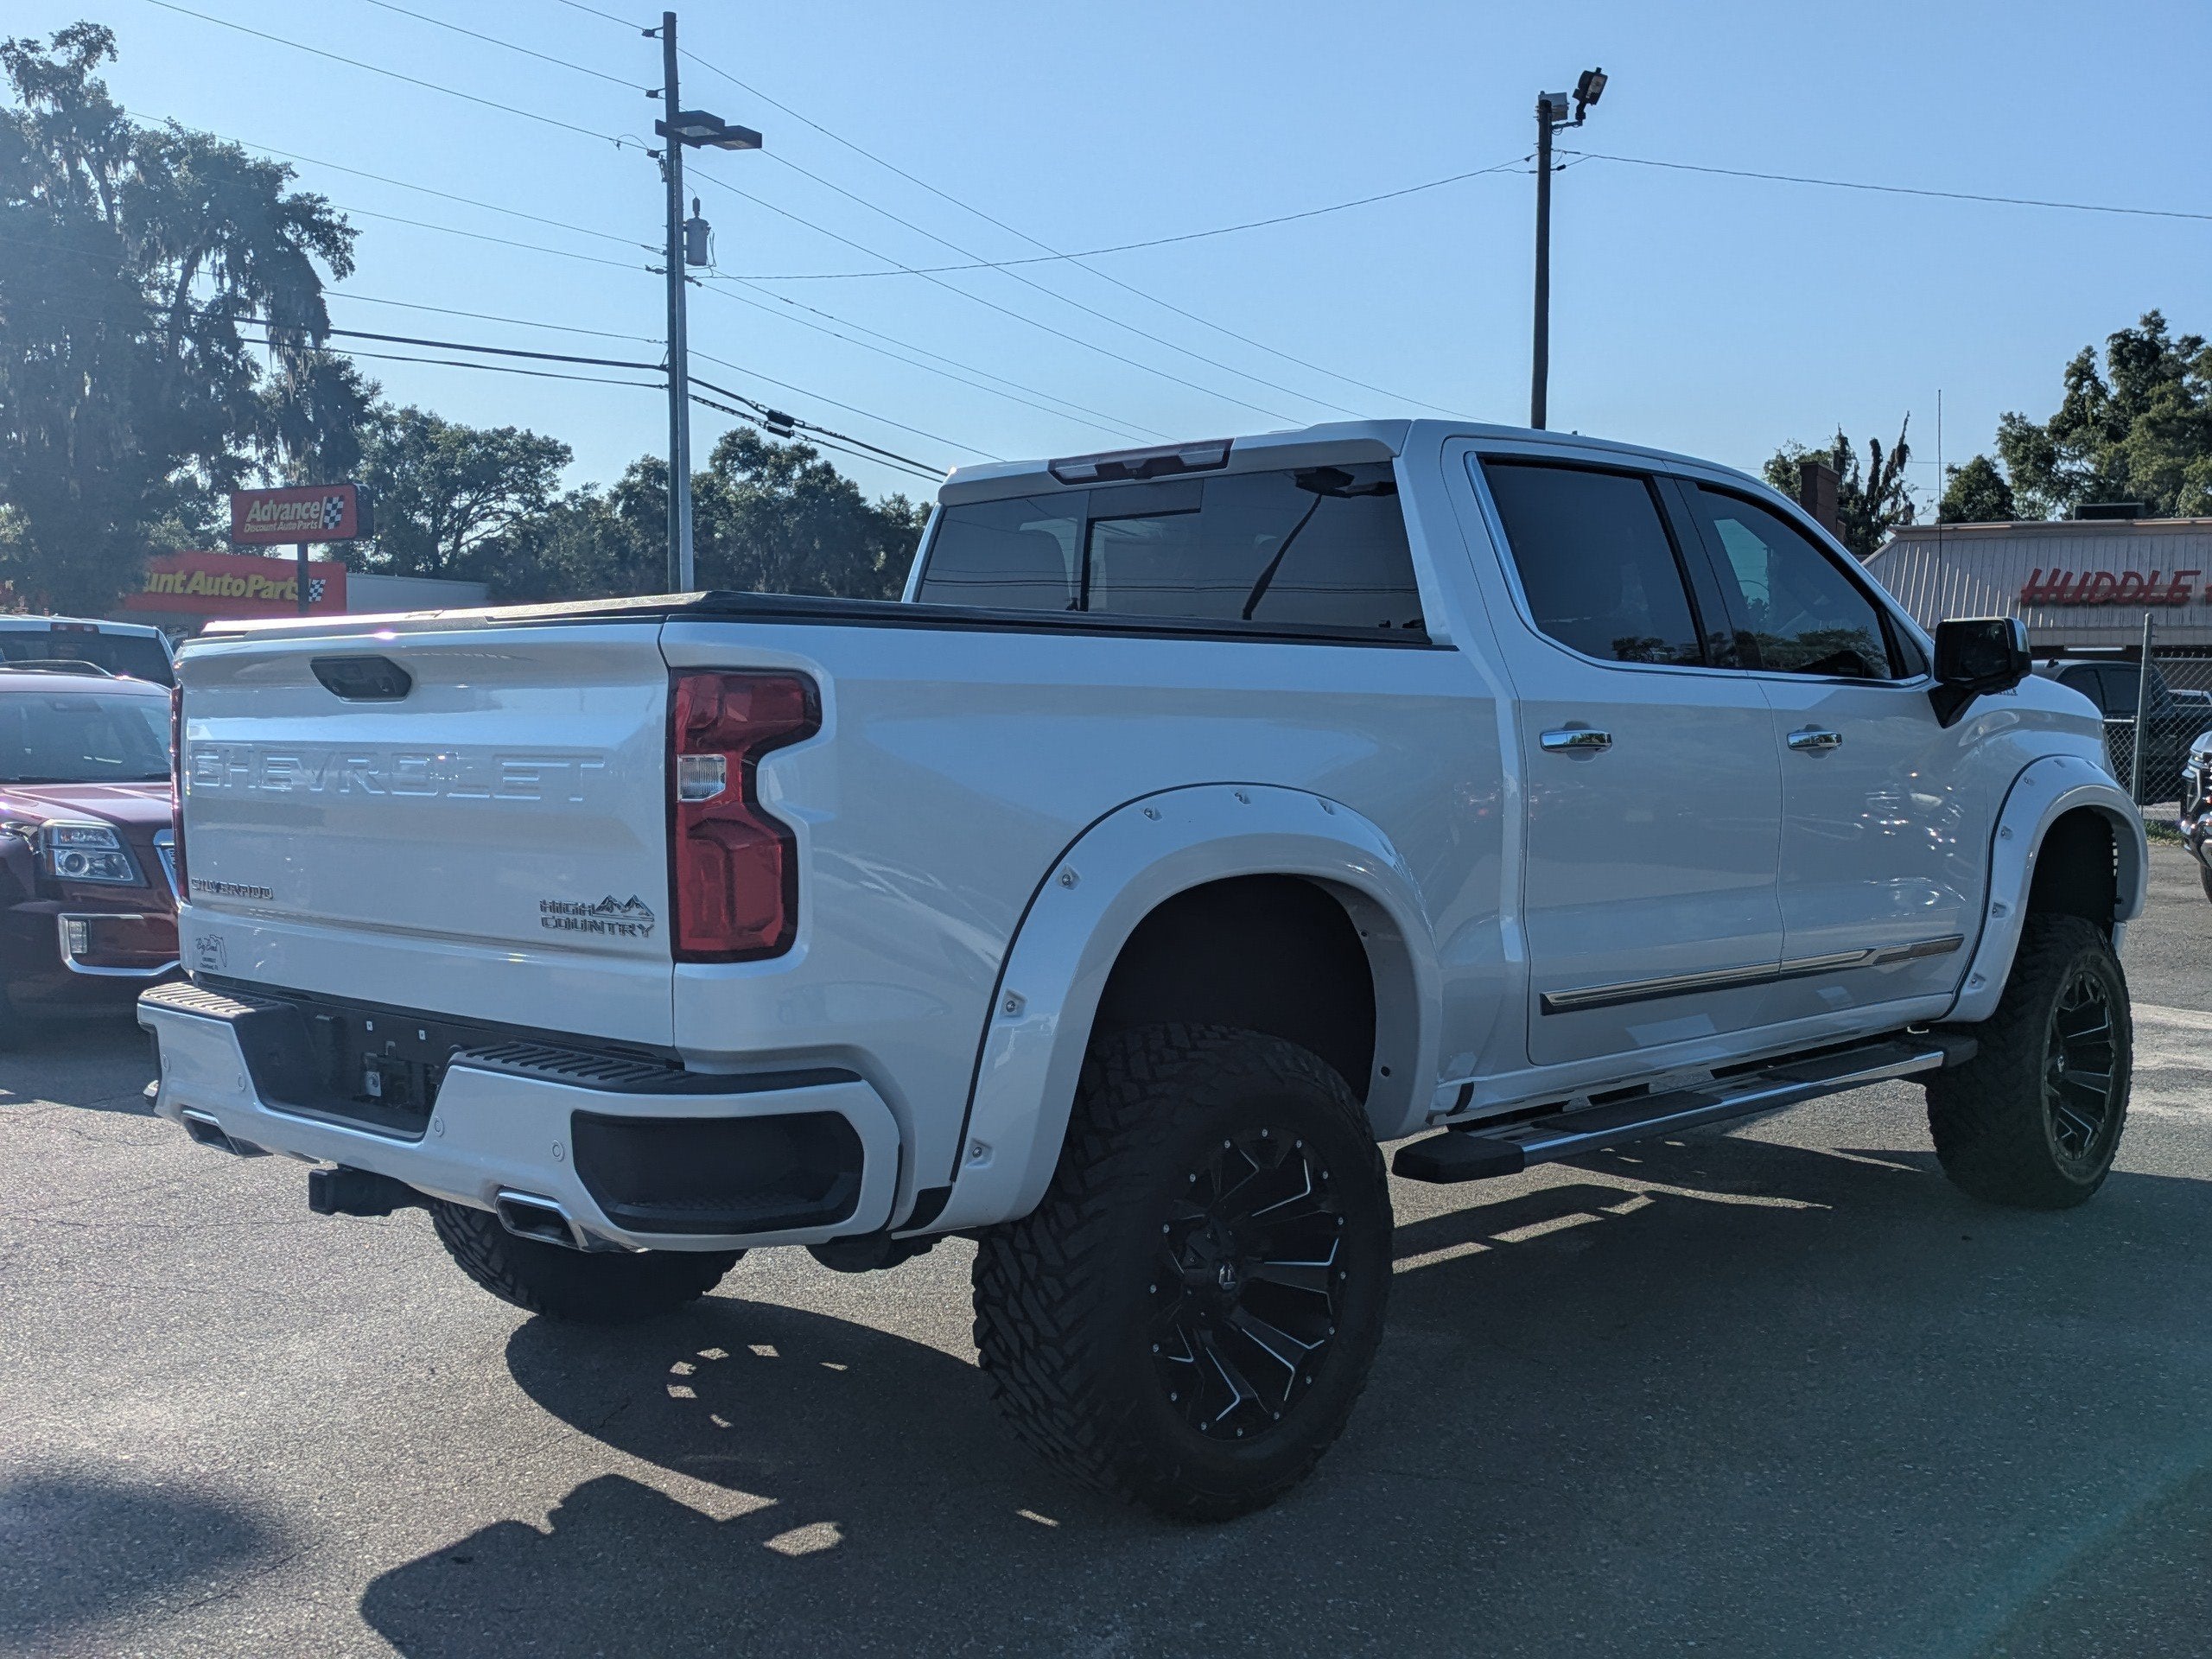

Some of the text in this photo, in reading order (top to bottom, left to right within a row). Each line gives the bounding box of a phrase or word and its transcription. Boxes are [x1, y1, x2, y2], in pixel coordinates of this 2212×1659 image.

[246, 499, 321, 523] Advance
[244, 520, 319, 533] Discount Auto Parts
[184, 570, 246, 597] Auto
[2020, 568, 2202, 605] HUDDLE
[192, 747, 605, 803] CHEVROLET
[191, 877, 274, 900] SILVERADO
[539, 899, 595, 917] HIGH
[541, 915, 655, 938] COUNTRY
